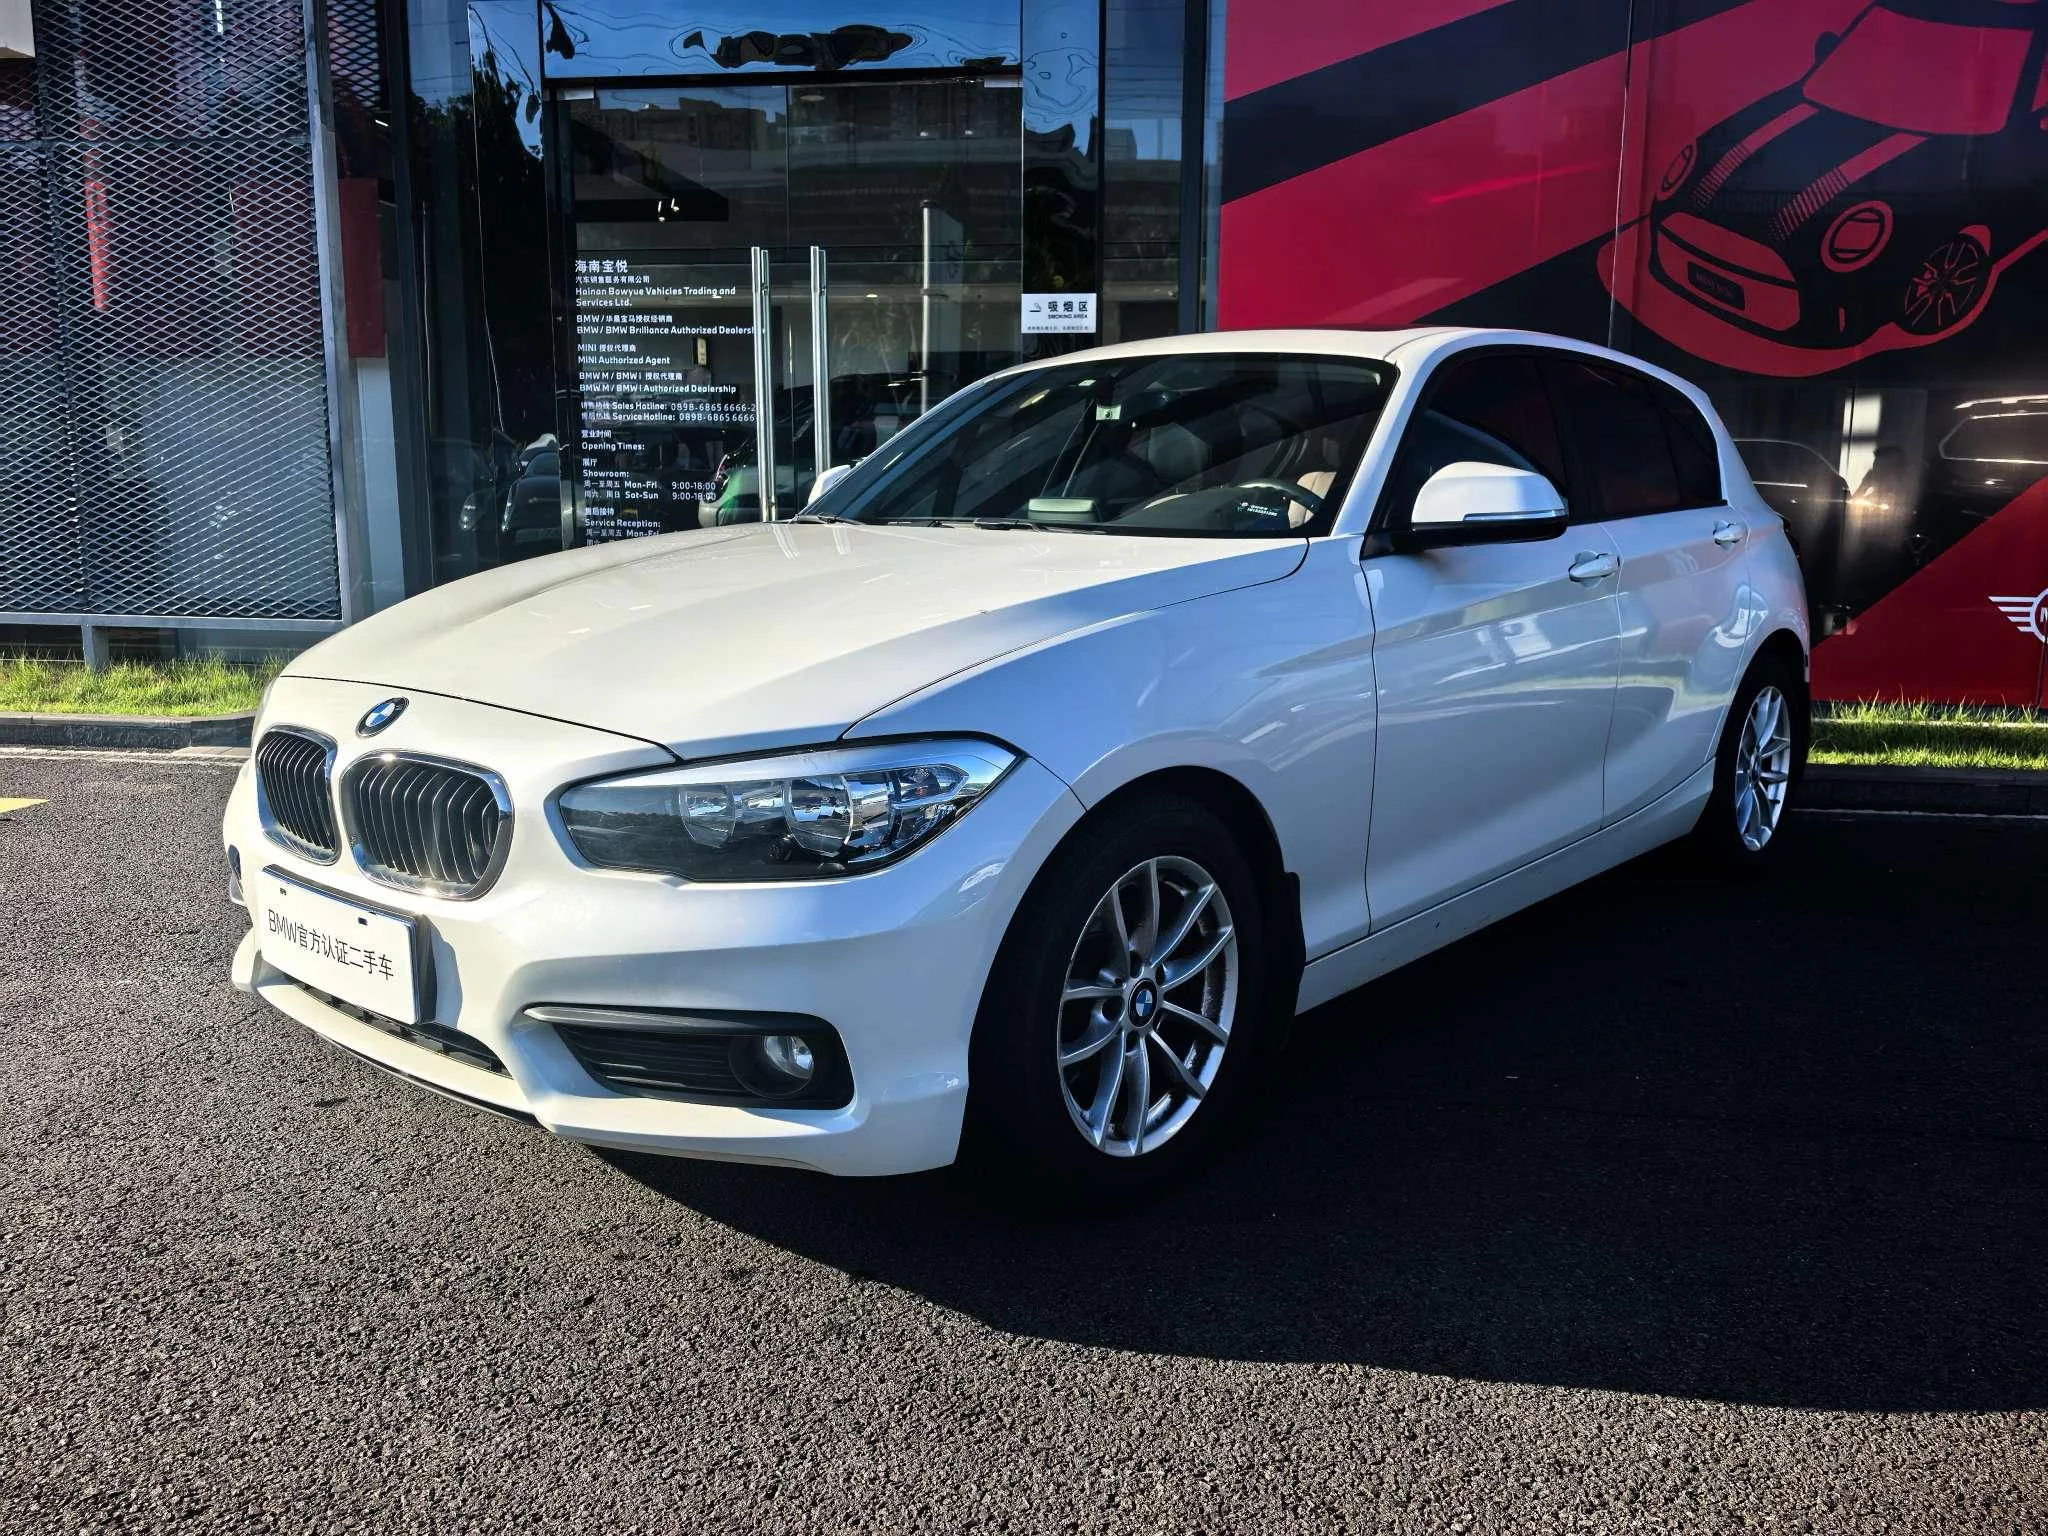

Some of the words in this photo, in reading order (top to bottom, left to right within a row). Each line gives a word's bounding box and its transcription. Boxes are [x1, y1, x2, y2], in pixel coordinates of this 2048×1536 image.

[575, 260, 628, 273] 海南宝悦
[576, 276, 650, 284] 汽车销售服务有限公司
[576, 287, 607, 296] Hainan
[608, 287, 644, 297] Bowyue
[645, 287, 682, 296] Vehicles
[683, 286, 717, 297] Trading
[719, 286, 736, 295] and
[576, 298, 613, 307] Services
[615, 298, 632, 307] Ltd.
[1047, 301, 1089, 312] 吸烟区
[576, 314, 600, 323] BMW
[576, 326, 599, 334] BMW
[605, 326, 628, 334] BMW
[629, 326, 669, 334] Brilliance
[670, 325, 718, 335] Authorized
[719, 325, 755, 335] Dealers
[577, 343, 597, 352] MINI
[599, 343, 636, 352] 授权代理商
[578, 355, 597, 364] MINI
[598, 355, 644, 364] Authorized
[645, 355, 671, 366] Agent
[579, 371, 601, 380] BMW
[616, 371, 638, 380] BMW
[645, 371, 683, 381] 授权代理商
[579, 384, 601, 392] BMW
[616, 384, 638, 392] BMW
[643, 384, 689, 393] Authorized
[690, 384, 737, 395] Dealership
[611, 401, 634, 410] Sales
[635, 401, 668, 410] Hotline:
[612, 412, 642, 421] Service
[643, 412, 676, 421] Hotline:
[581, 429, 612, 438] 营业时间
[581, 441, 616, 452] Opening
[617, 442, 645, 450] Times:
[582, 469, 630, 478] Showroom:
[624, 480, 657, 489] Mon-Fri
[671, 481, 716, 490] 9:00-18:00
[625, 491, 659, 499] Sat-Sun
[585, 518, 616, 527] Service
[616, 519, 661, 529] Reception:
[267, 908, 395, 981] BMW官方认证二手车
